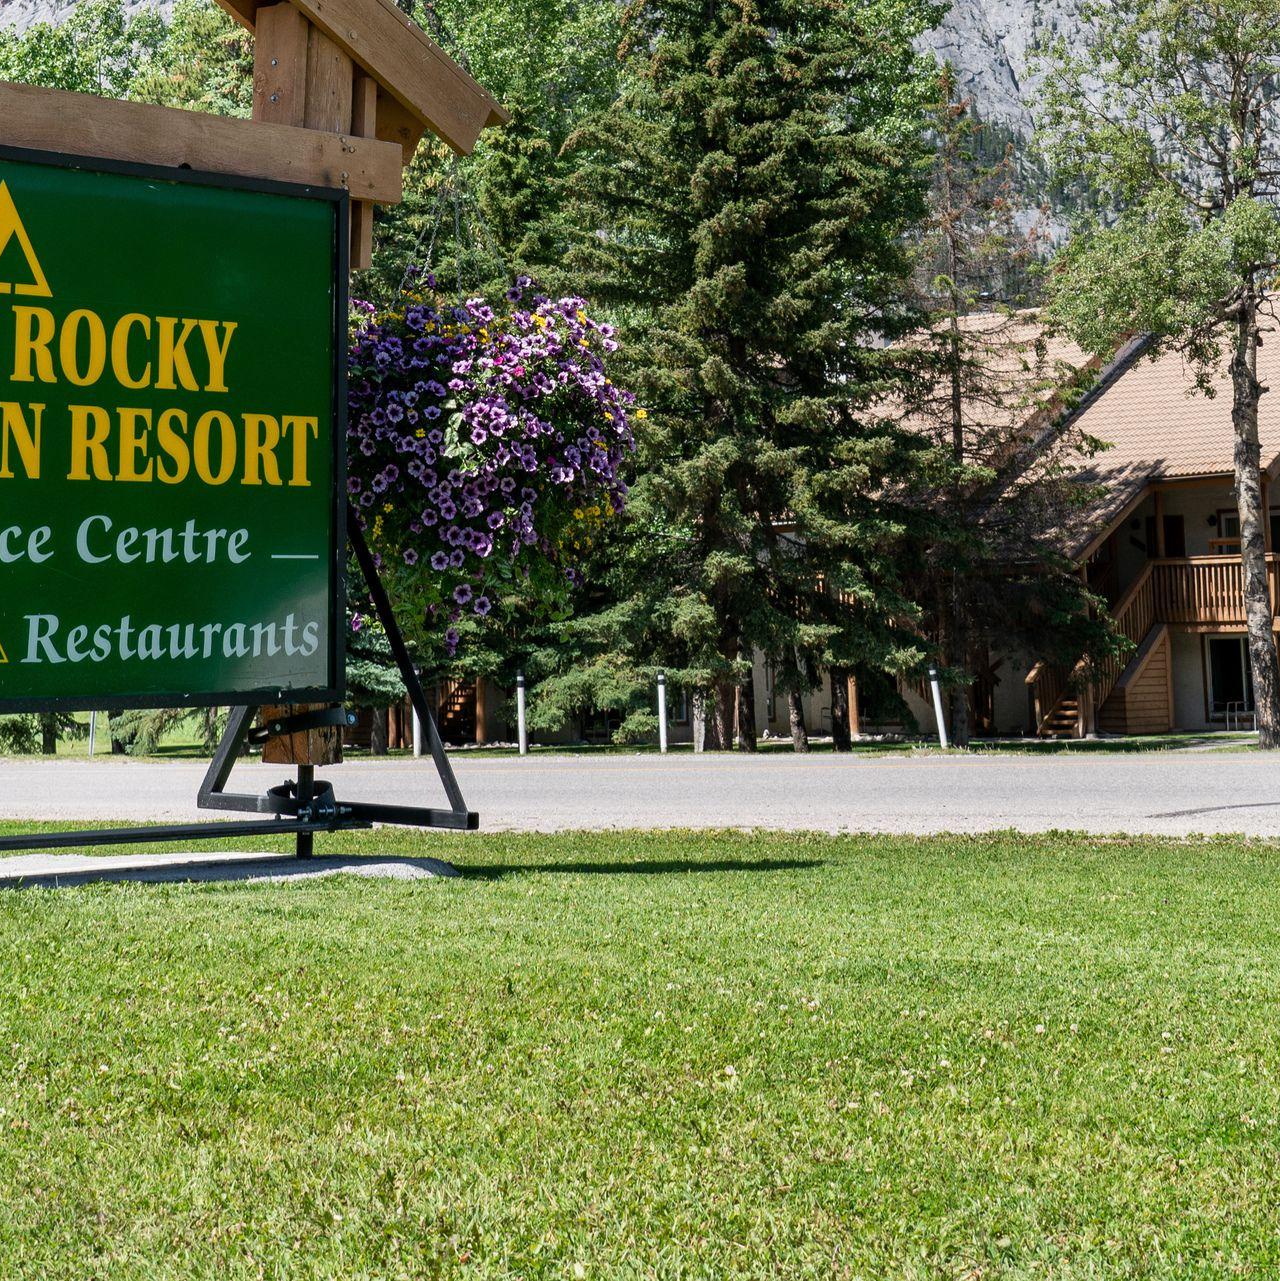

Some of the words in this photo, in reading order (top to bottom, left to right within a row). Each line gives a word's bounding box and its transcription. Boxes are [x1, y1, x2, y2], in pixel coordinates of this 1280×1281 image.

[9, 305, 238, 393] ROCKY
[66, 404, 319, 487] RESORT
[76, 515, 252, 564] Centre
[20, 612, 320, 664] Restaurants
